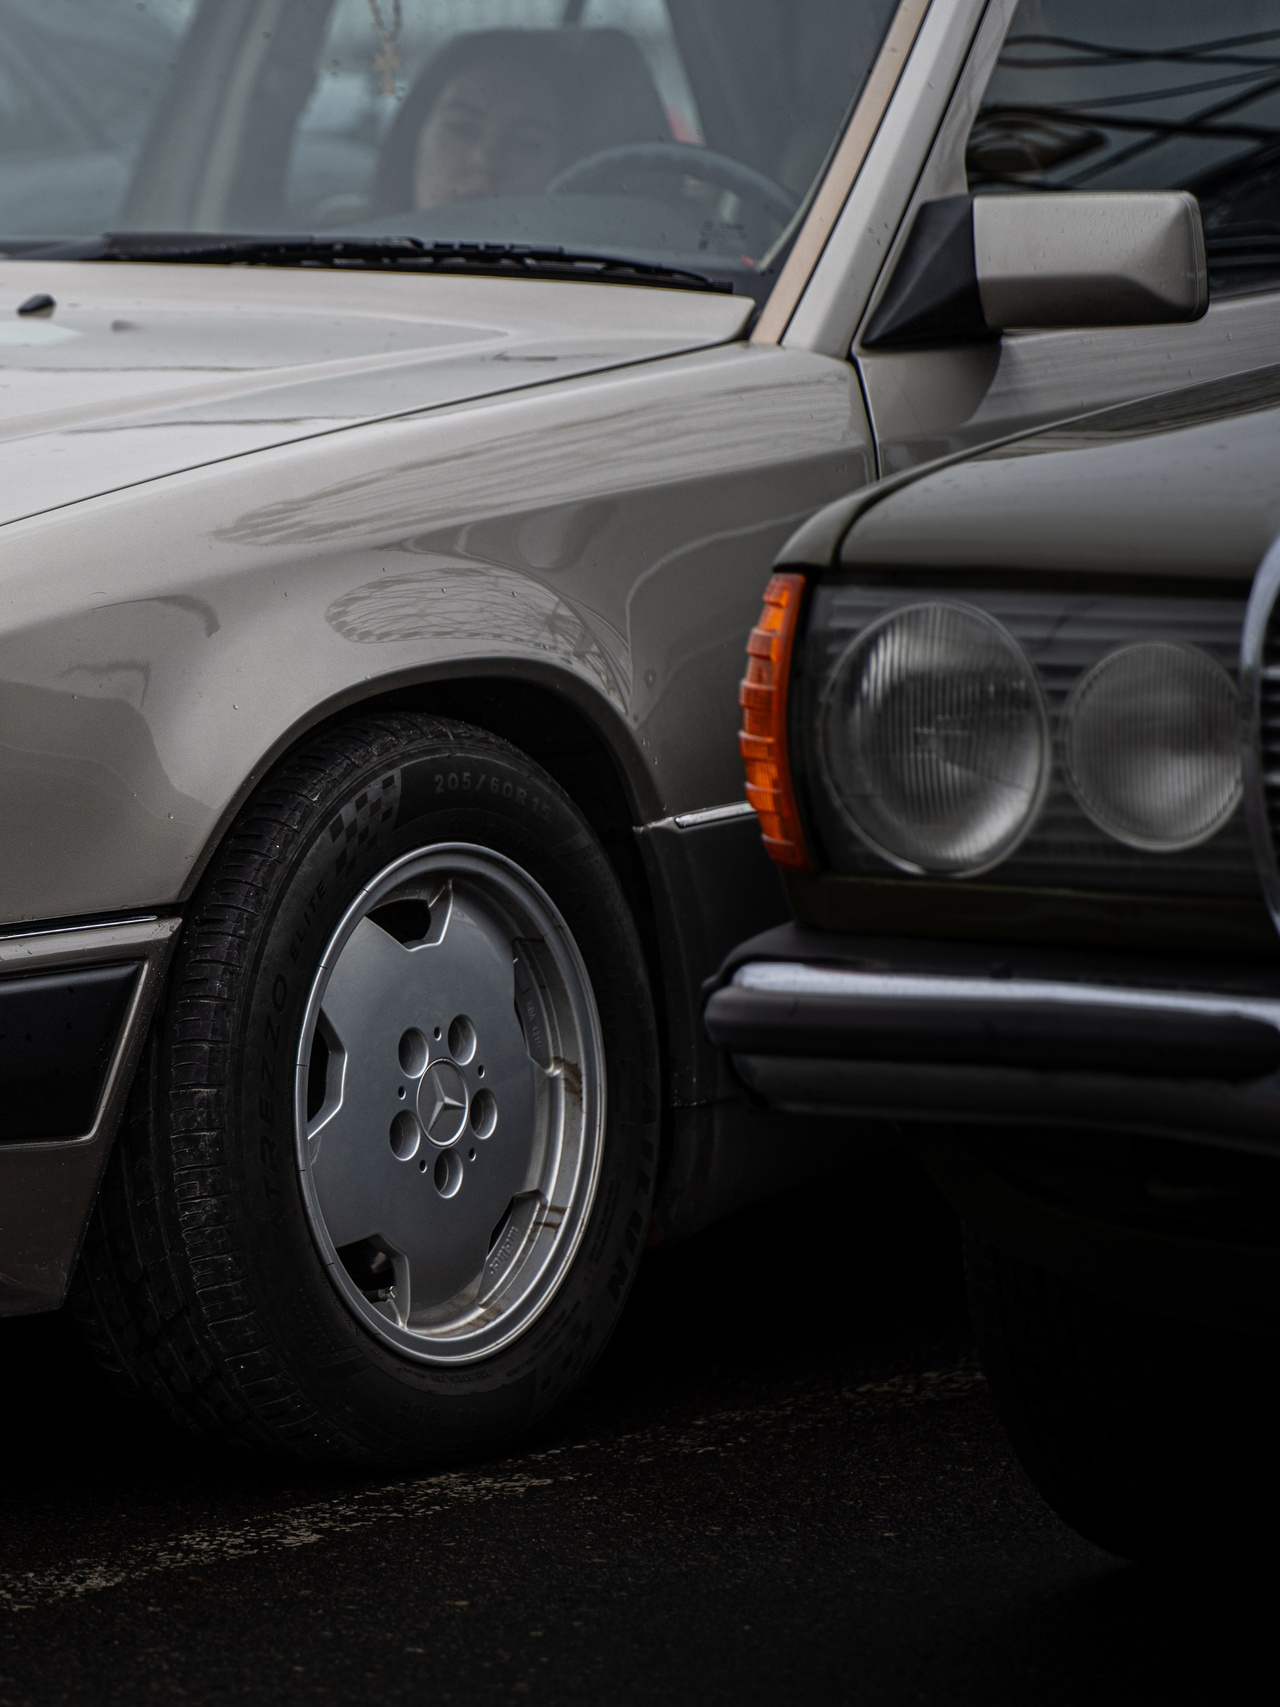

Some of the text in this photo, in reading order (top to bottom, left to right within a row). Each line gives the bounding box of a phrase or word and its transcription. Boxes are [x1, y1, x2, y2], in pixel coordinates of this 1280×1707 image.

[434, 773, 552, 821] 205/60R15
[258, 879, 327, 1232] ATREZZO ELITE
